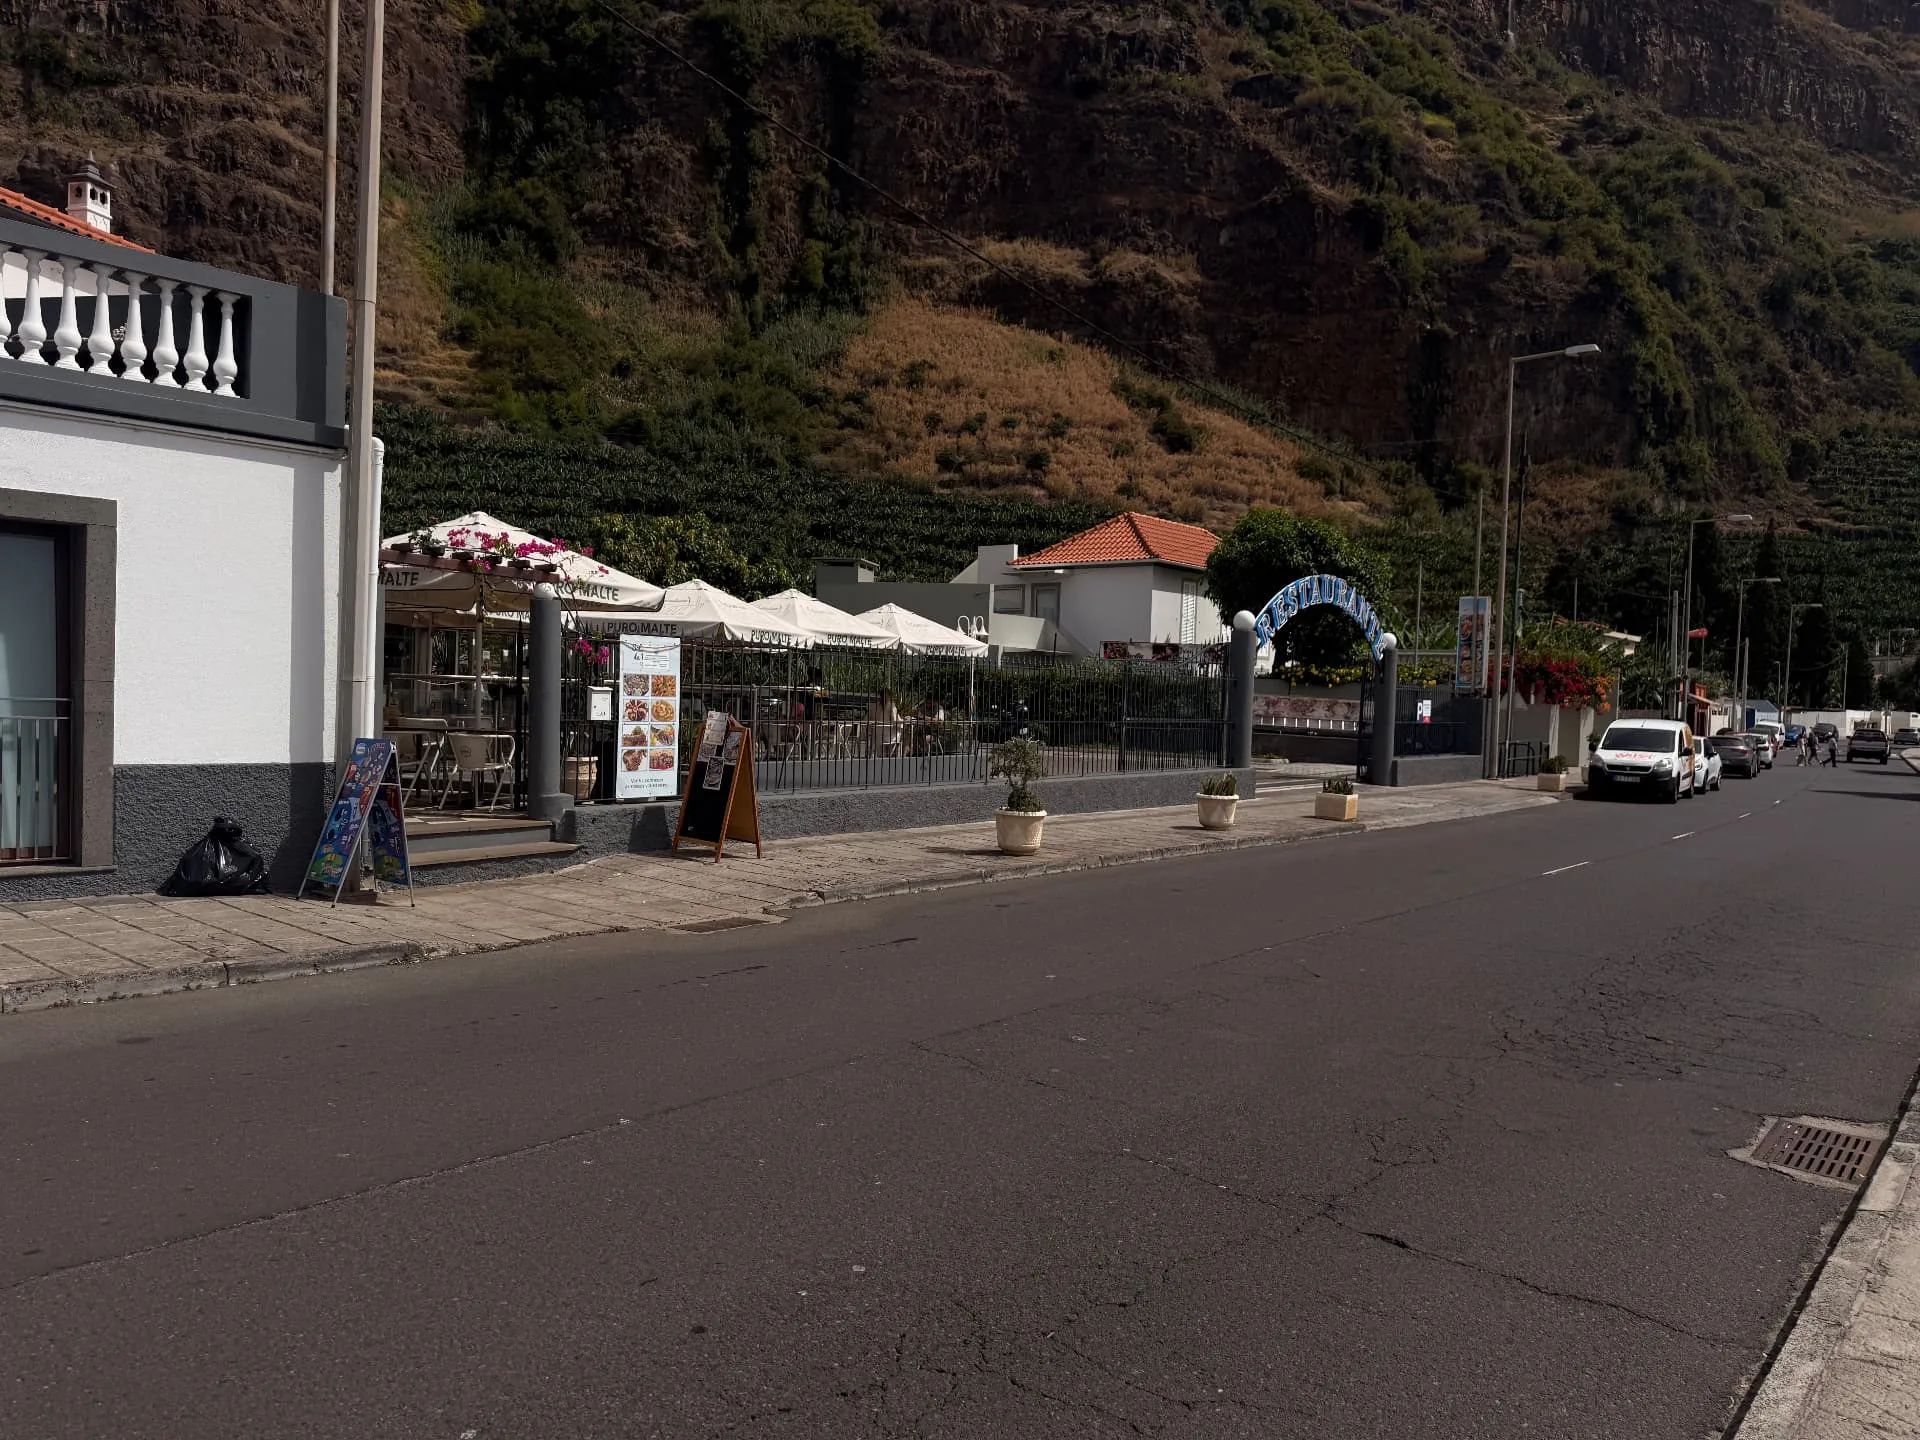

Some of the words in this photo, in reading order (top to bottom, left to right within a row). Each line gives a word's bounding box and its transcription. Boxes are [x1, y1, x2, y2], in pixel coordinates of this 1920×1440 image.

[579, 583, 620, 602] MALTE
[607, 622, 638, 634] PURO
[640, 622, 677, 635] MALTE
[751, 629, 770, 642] PURO
[827, 633, 848, 644] PURO
[849, 635, 873, 647] MALTE
